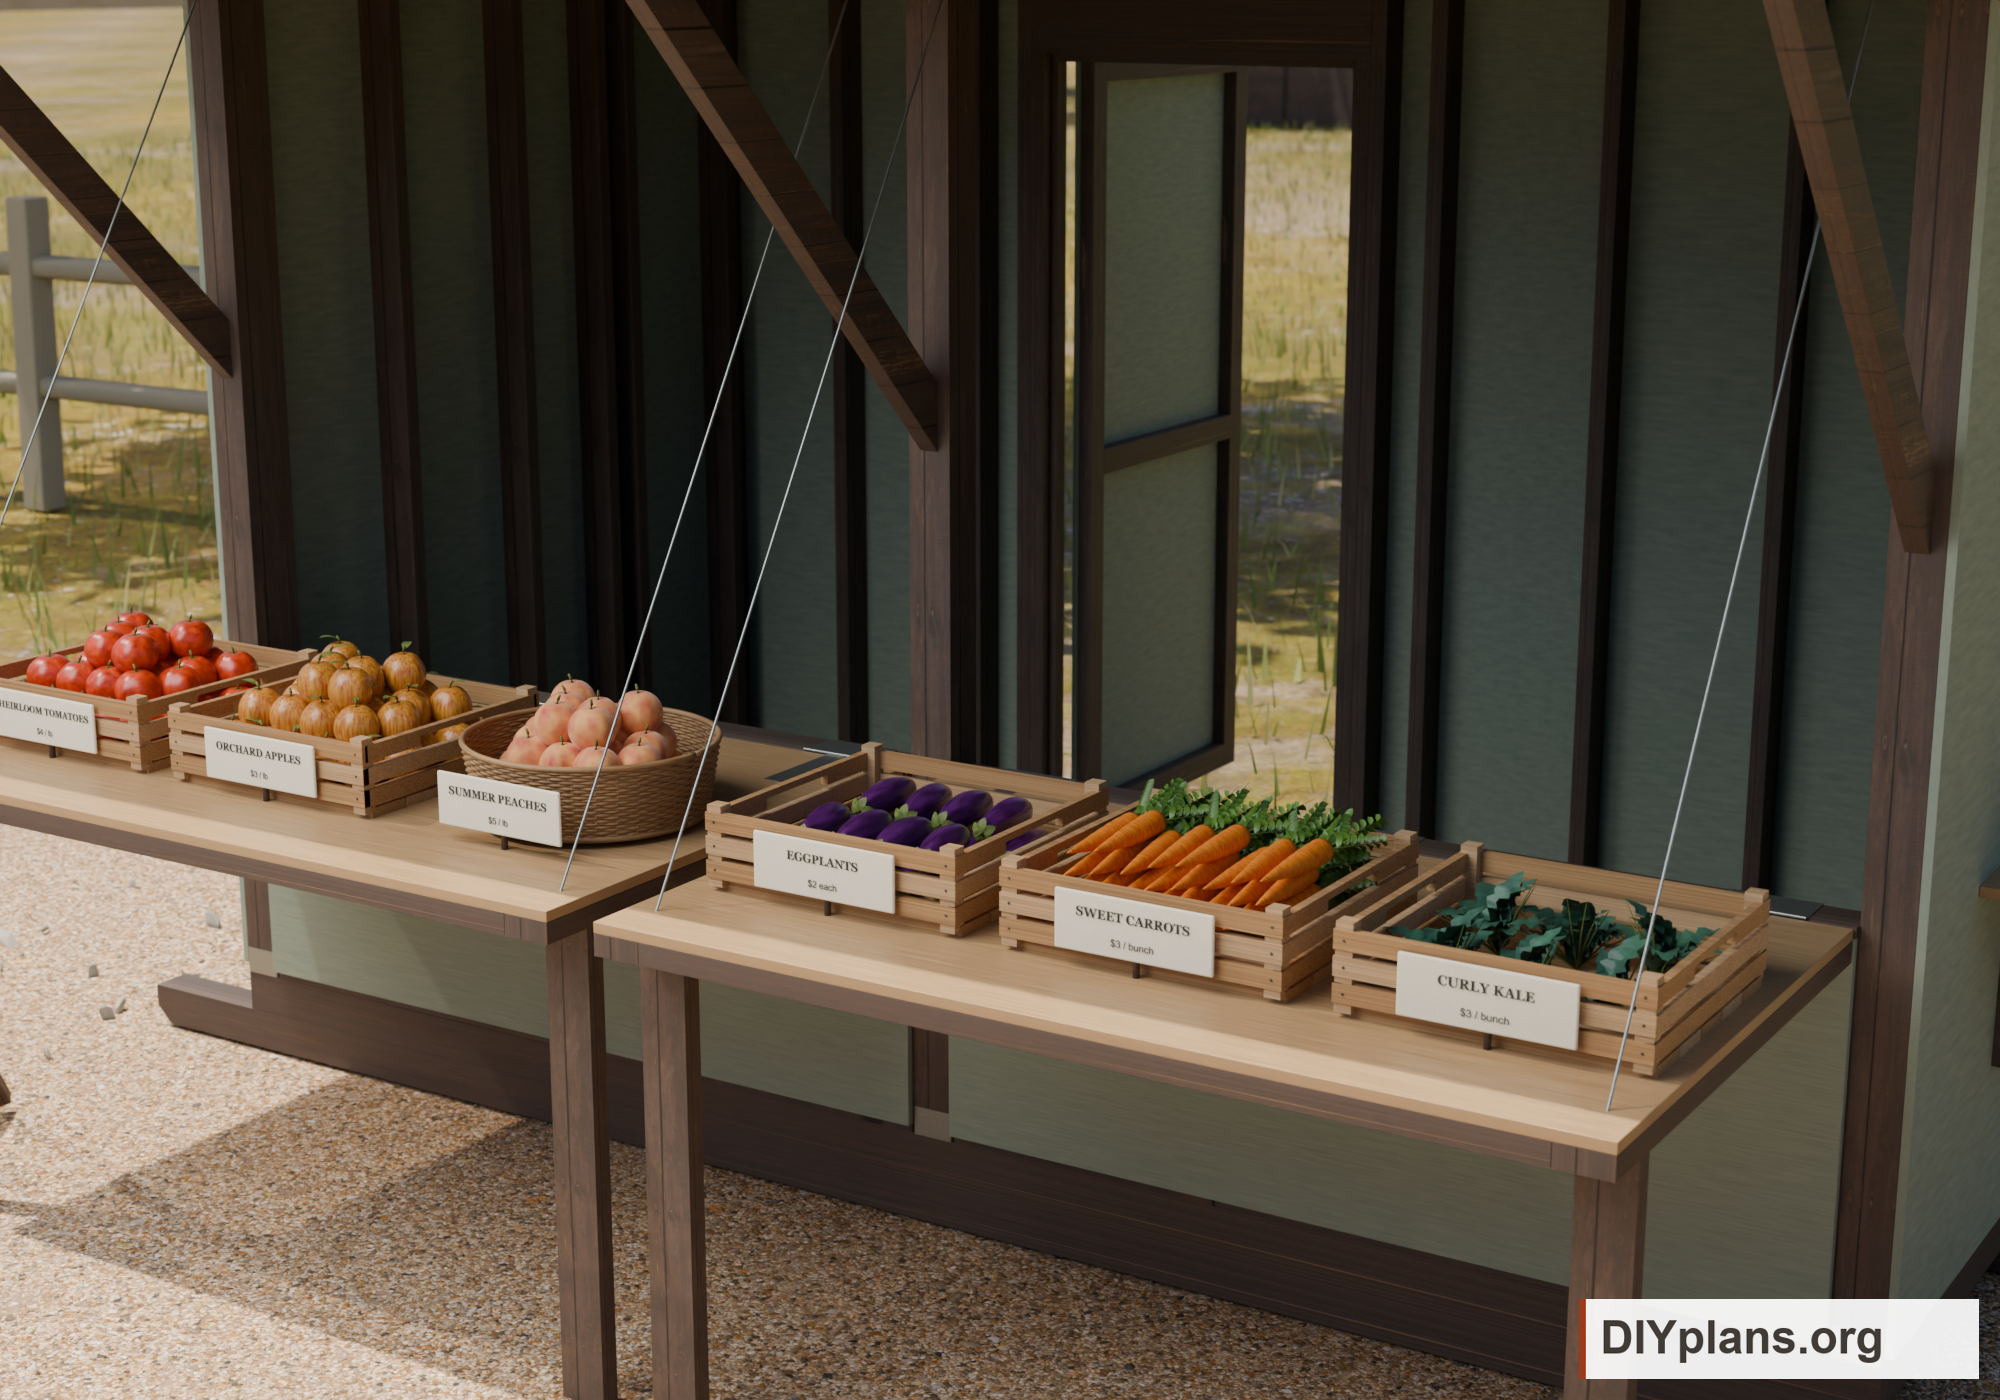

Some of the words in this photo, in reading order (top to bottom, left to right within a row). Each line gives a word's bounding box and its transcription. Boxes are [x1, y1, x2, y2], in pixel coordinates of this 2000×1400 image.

[0, 700, 43, 715] HEIRLOOM
[43, 708, 89, 724] TOMATOES
[216, 740, 263, 758] ORCHARD
[265, 750, 301, 765] APPLES
[250, 769, 258, 778] $3
[263, 772, 268, 780] lb
[448, 785, 496, 803] SUMMER
[498, 794, 547, 813] PEACHES
[488, 816, 497, 826] $5
[502, 819, 508, 828] lb
[786, 849, 859, 873] EGGPLANTS
[807, 879, 817, 889] $2
[818, 882, 838, 893] each
[1075, 905, 1123, 924] SWEET
[1126, 915, 1191, 937] CARROTS
[1110, 938, 1121, 949] $3
[1128, 943, 1154, 956] bunch
[1437, 974, 1490, 994] CURLY
[1493, 985, 1536, 1004] KALE
[1459, 1007, 1472, 1019] $3
[1480, 1012, 1510, 1026] bunch
